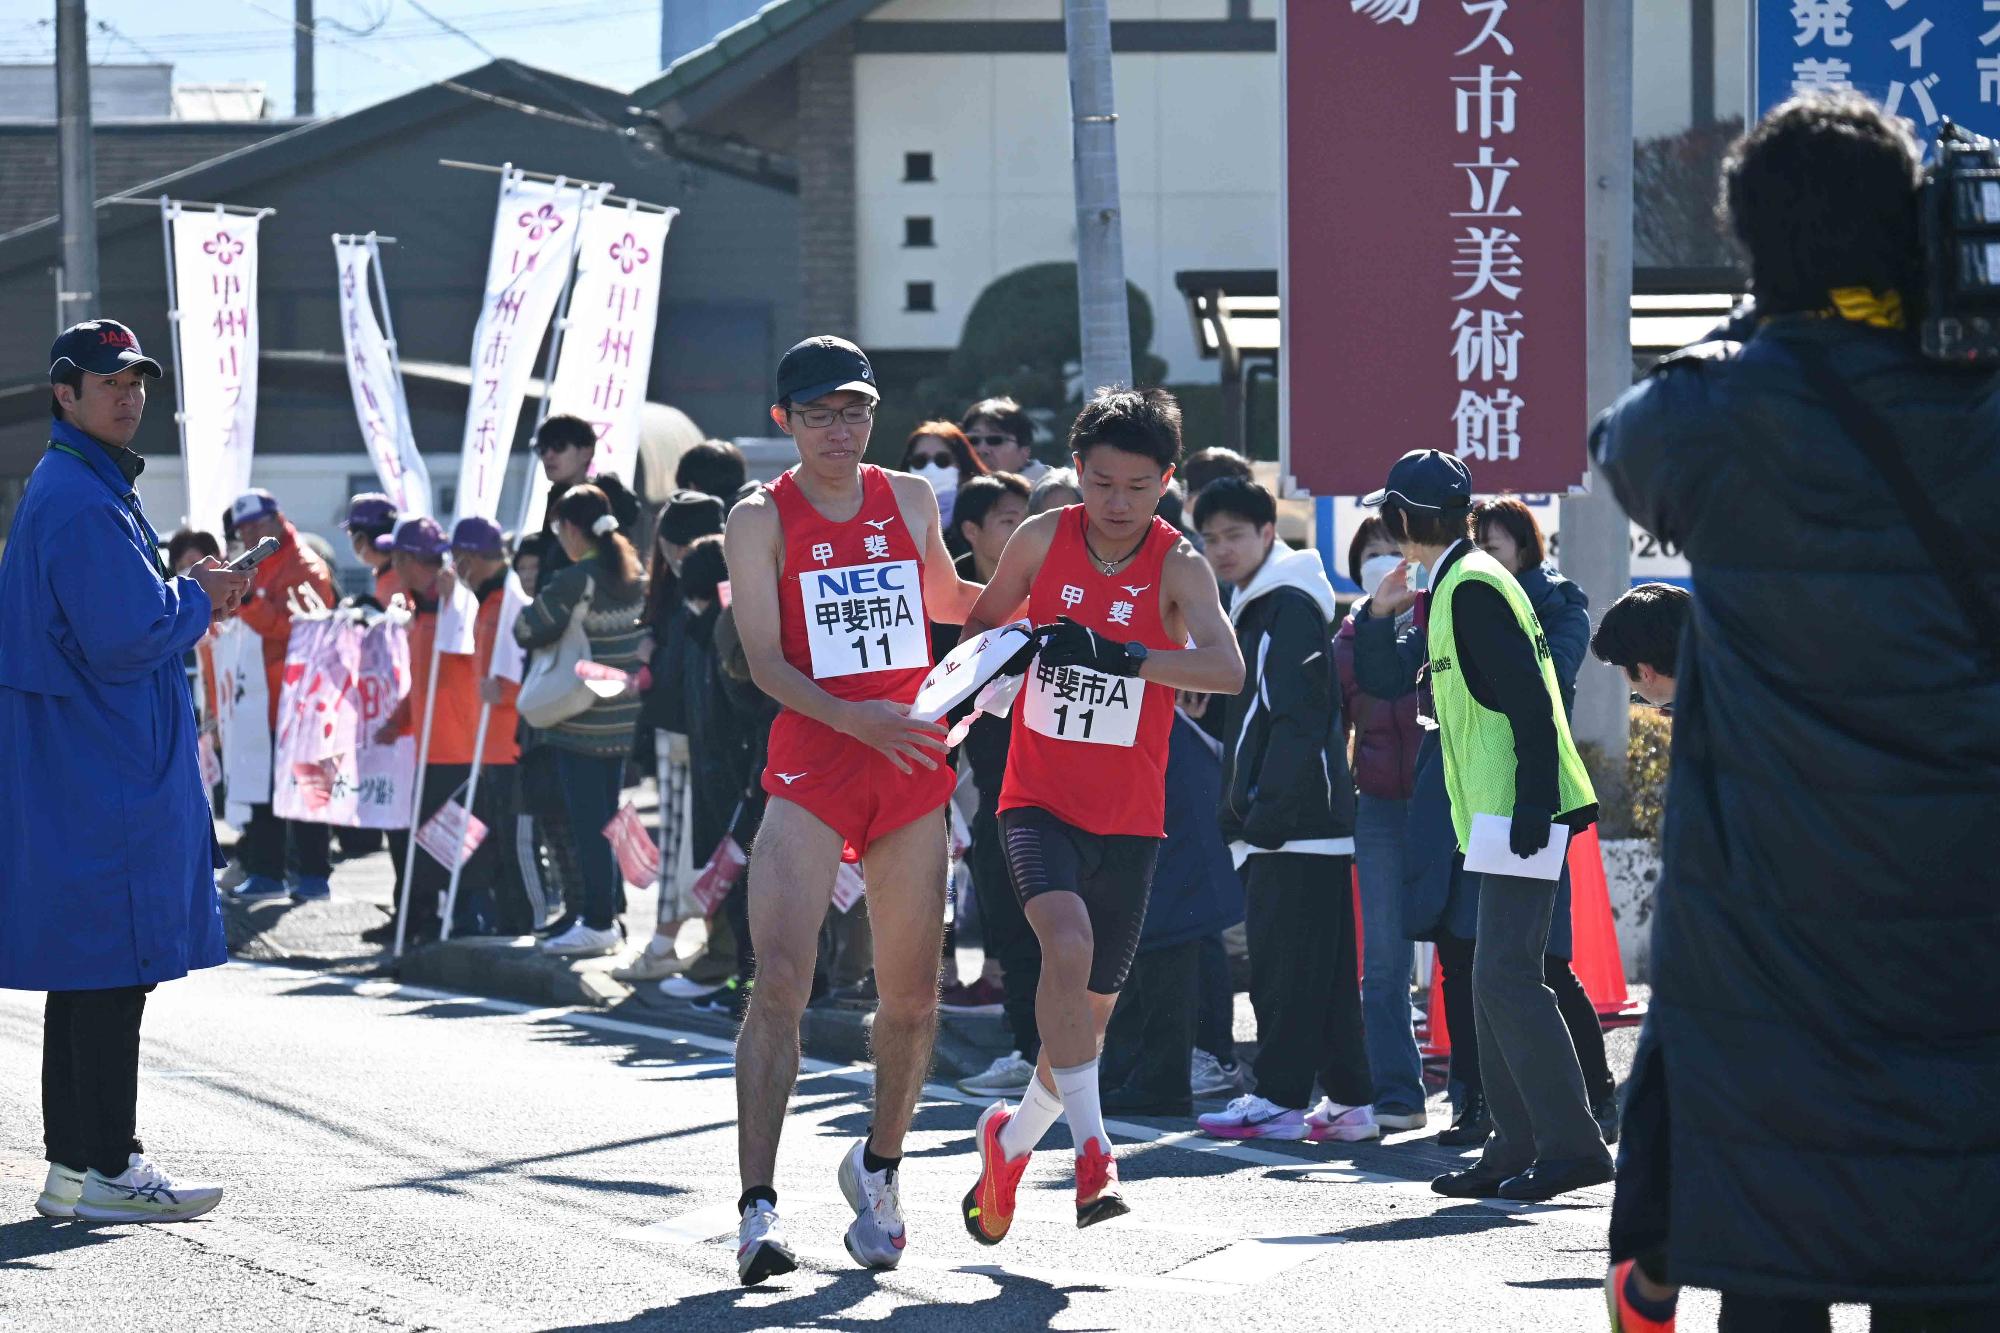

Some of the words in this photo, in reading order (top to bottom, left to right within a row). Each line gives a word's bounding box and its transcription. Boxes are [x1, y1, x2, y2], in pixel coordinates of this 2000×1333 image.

[1449, 0, 1525, 462] ス市立美術館
[817, 565, 905, 598] NEC
[815, 594, 915, 636] 甲斐市A
[851, 632, 892, 669] 11
[1036, 664, 1129, 710] 甲斐市A
[1053, 704, 1095, 739] 11
